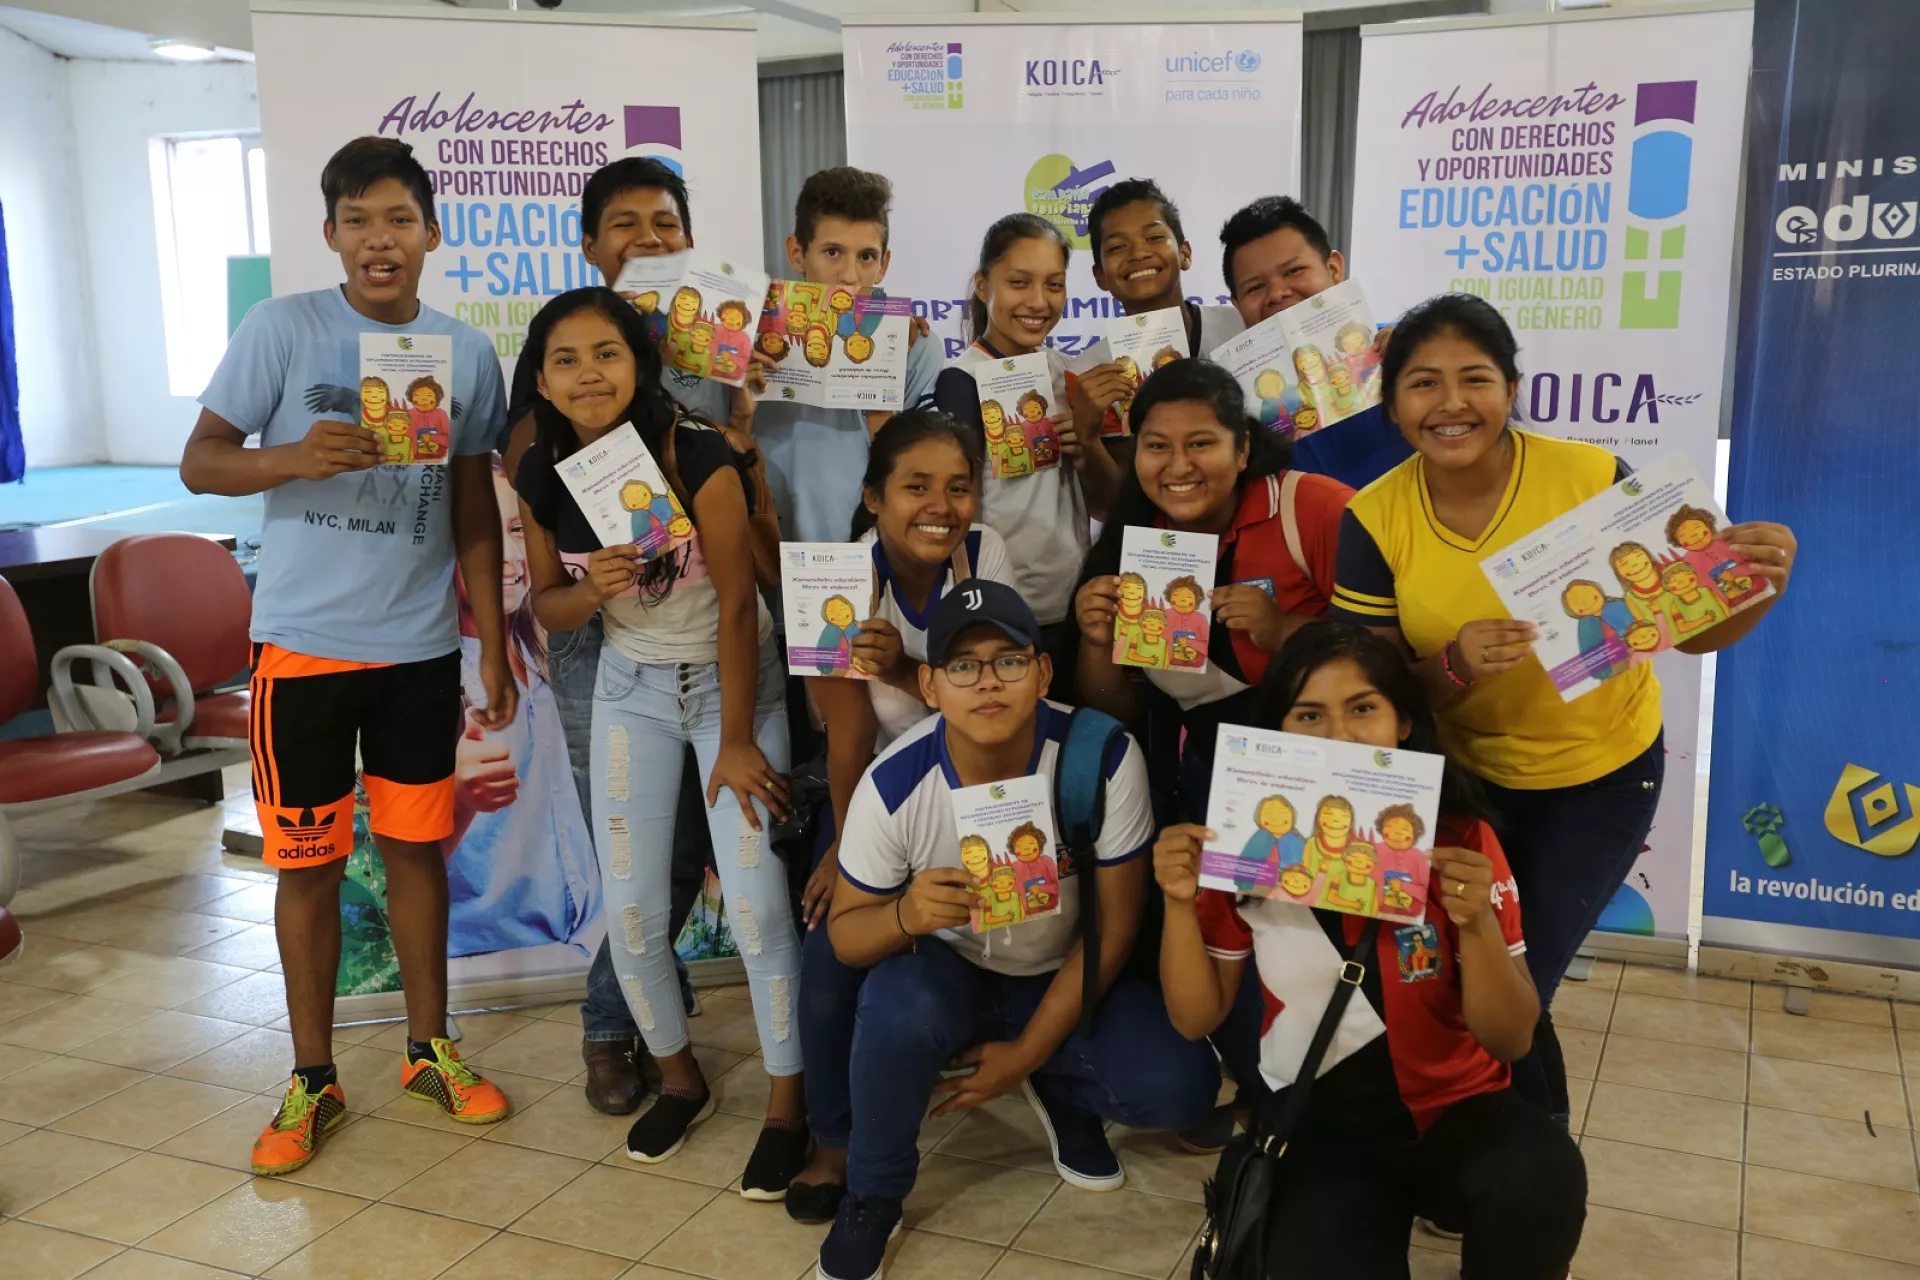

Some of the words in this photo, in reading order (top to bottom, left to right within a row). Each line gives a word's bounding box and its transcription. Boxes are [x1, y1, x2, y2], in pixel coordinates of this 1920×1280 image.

[886, 41, 944, 53] Adolescentes
[1026, 59, 1103, 86] KOICA
[1165, 50, 1233, 73] unicef
[1165, 89, 1194, 103] para
[1197, 87, 1229, 101] cada
[1232, 87, 1261, 101] niño
[1401, 81, 1626, 129] Adolescentes
[378, 91, 614, 135] Adolescentes
[1452, 127, 1494, 151] CON
[1500, 121, 1616, 150] DERECHOS
[438, 139, 484, 165] CON
[491, 140, 608, 166] DERECHOS
[1418, 158, 1430, 181] Y
[1435, 151, 1614, 181] OPORTUNIDADES
[427, 170, 597, 197] OPORTUNIDAD
[1399, 182, 1611, 229] EDUCACIÓN
[433, 202, 583, 248] UCACIÓ
[1444, 229, 1608, 273] +SALUD
[1773, 266, 1843, 281] ESTADO
[1450, 277, 1491, 300] CON
[1497, 276, 1604, 301] IGUALDAD
[455, 302, 500, 328] CON
[1517, 302, 1603, 330] GÉNERO
[432, 465, 445, 501] MANI
[412, 465, 435, 546] XCHANGE
[304, 510, 341, 531] NYC,
[347, 518, 395, 535] MILAN
[812, 554, 834, 563] KOICA
[1256, 743, 1282, 755] KOICA
[277, 843, 335, 859] adidas
[1730, 869, 1751, 893] la
[1757, 877, 1885, 908] revolución
